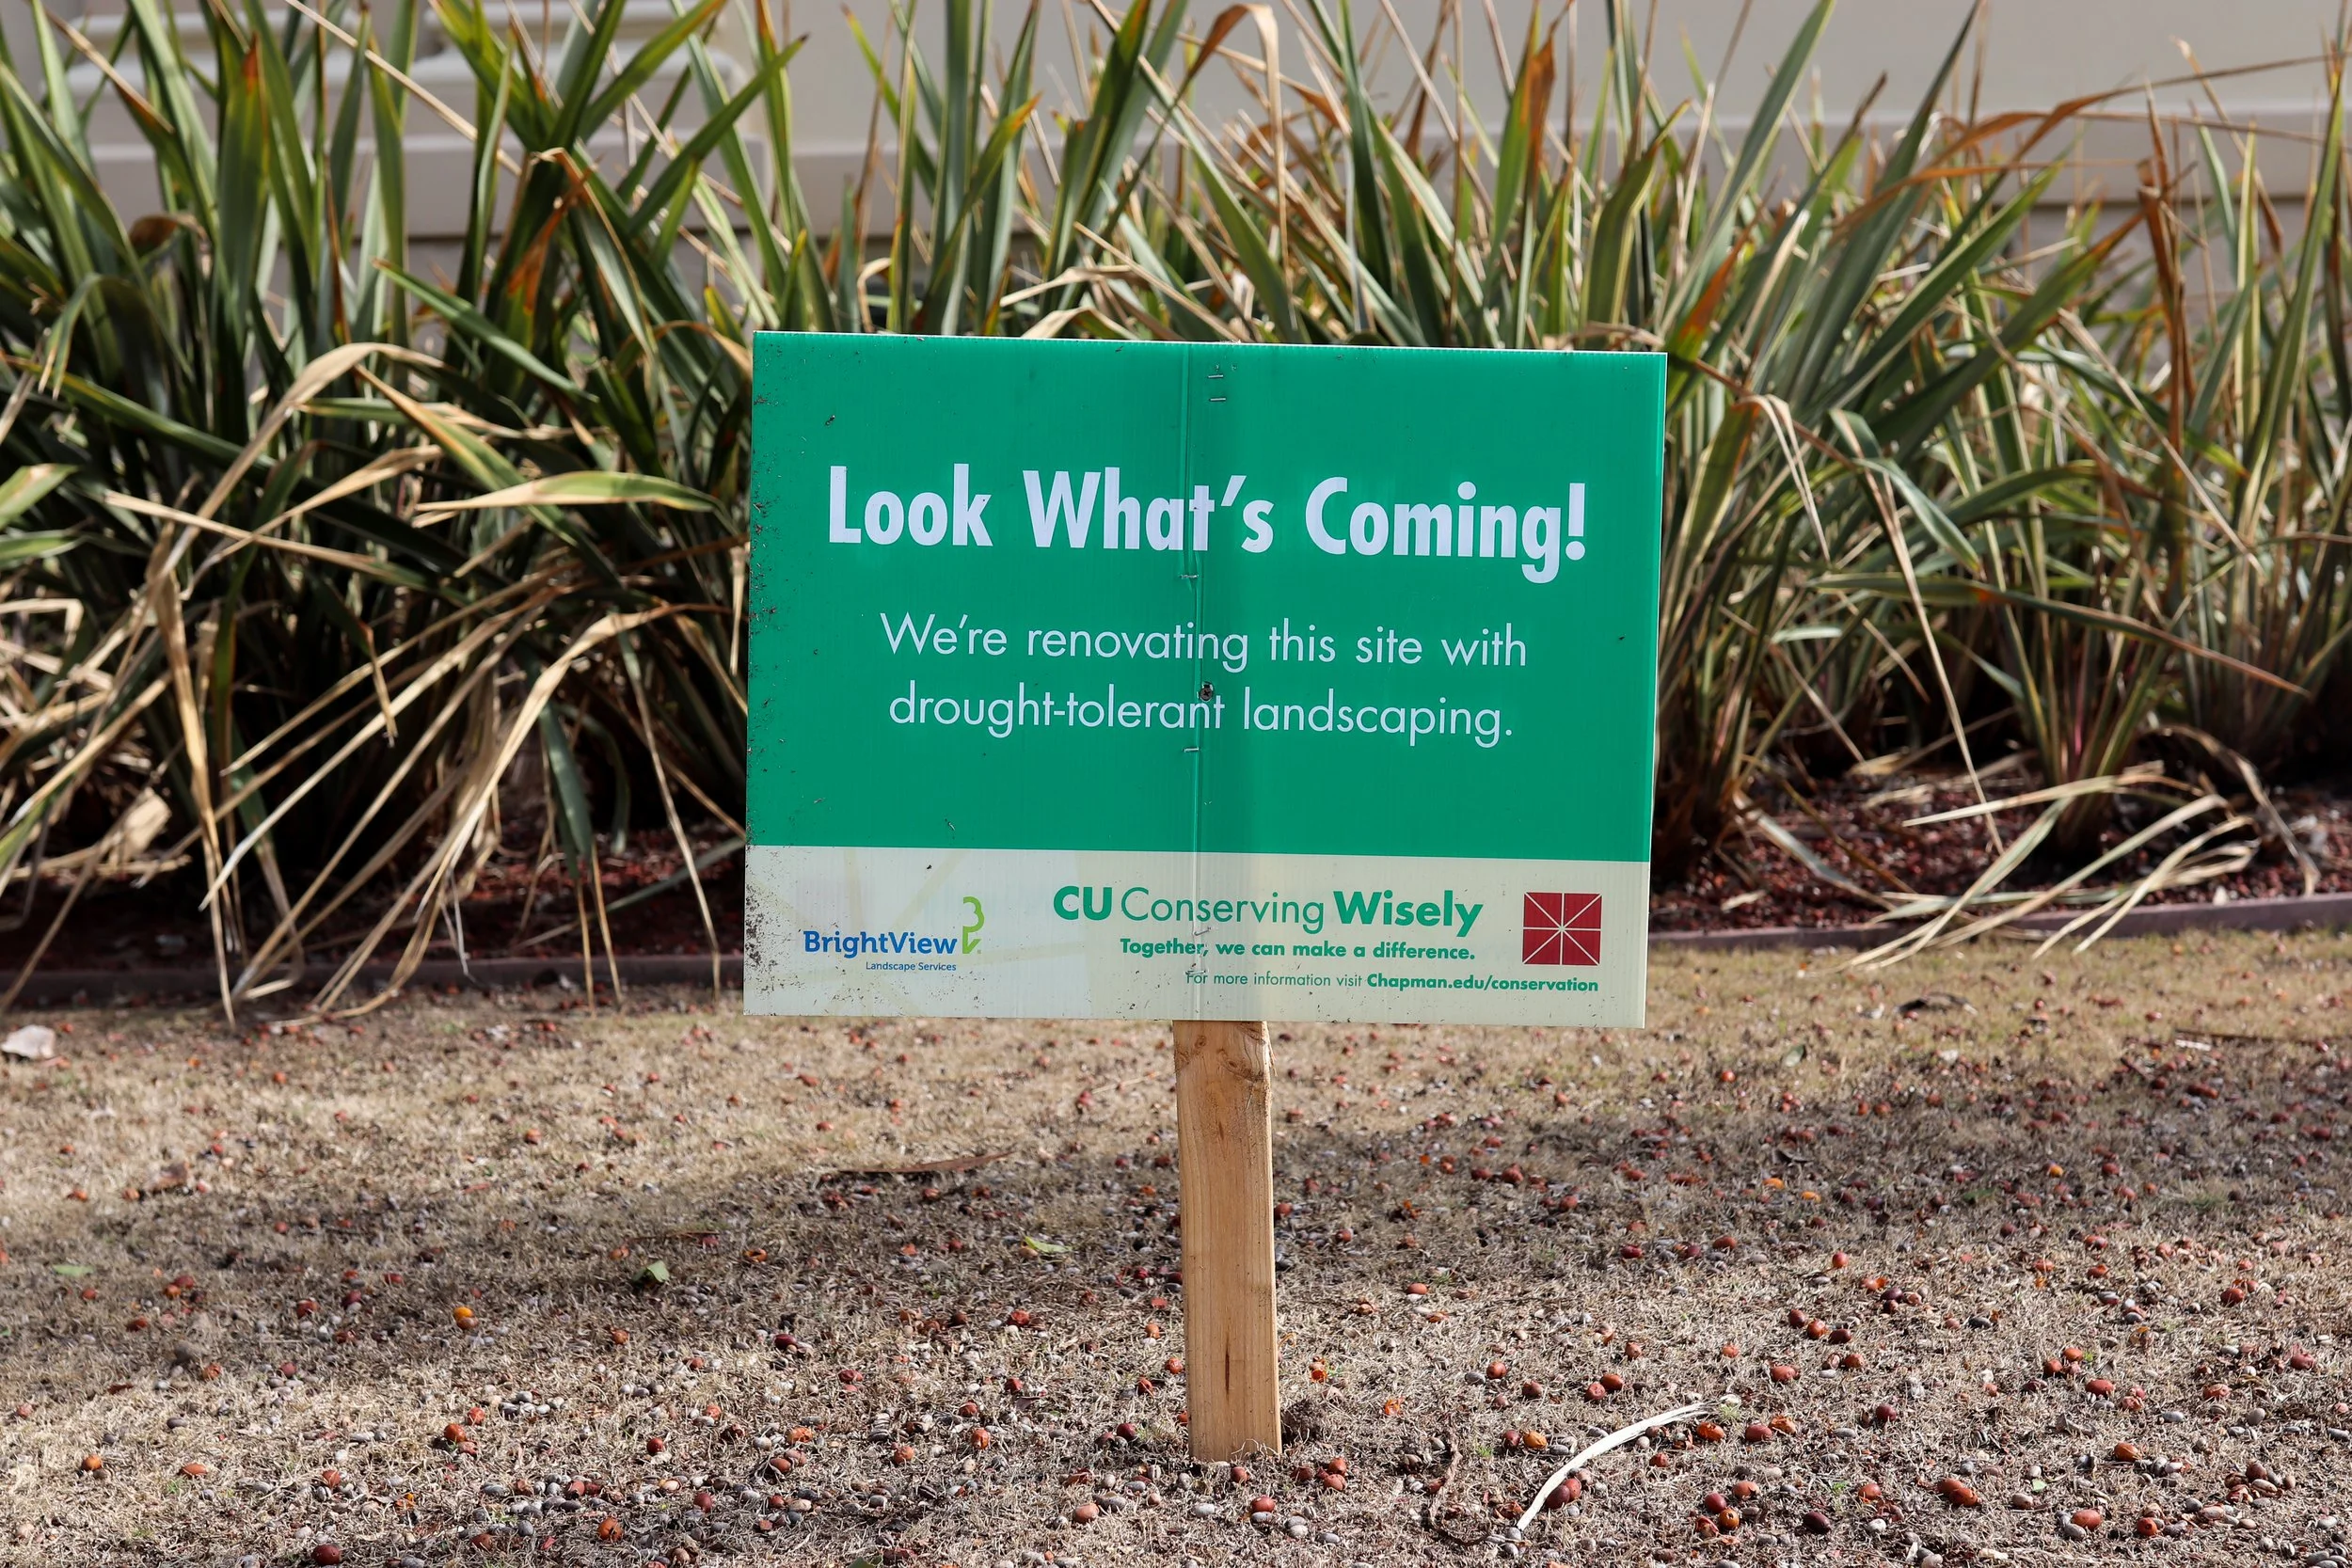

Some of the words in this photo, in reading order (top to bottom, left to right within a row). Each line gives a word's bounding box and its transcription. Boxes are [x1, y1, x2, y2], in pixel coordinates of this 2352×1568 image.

[829, 464, 993, 547] Look
[1023, 467, 1274, 554] What's
[1306, 477, 1586, 584] Coming!
[880, 611, 1007, 657] We're
[1028, 621, 1249, 673] renovating
[1269, 618, 1337, 663] this
[1356, 623, 1422, 666] site
[1440, 623, 1528, 667] with
[889, 680, 1224, 738] drought-tolerant
[1243, 687, 1512, 748] landscaping.
[1054, 886, 1113, 921] CU
[1121, 887, 1324, 935] Conserving
[1333, 890, 1484, 937] Wisely
[803, 930, 957, 958] BrightView
[1120, 938, 1209, 959] Together,
[1216, 944, 1245, 957] we
[1252, 944, 1285, 958] can
[1293, 942, 1346, 958] make
[1353, 947, 1366, 958] a
[1373, 942, 1475, 960] difference.
[866, 961, 915, 972] Landscape
[918, 962, 956, 971] Services
[1186, 973, 1208, 985] For
[1213, 974, 1248, 986] more
[1253, 972, 1332, 988] information
[1336, 973, 1363, 988] visit
[1367, 974, 1598, 992] Chapman.edu/conservation
